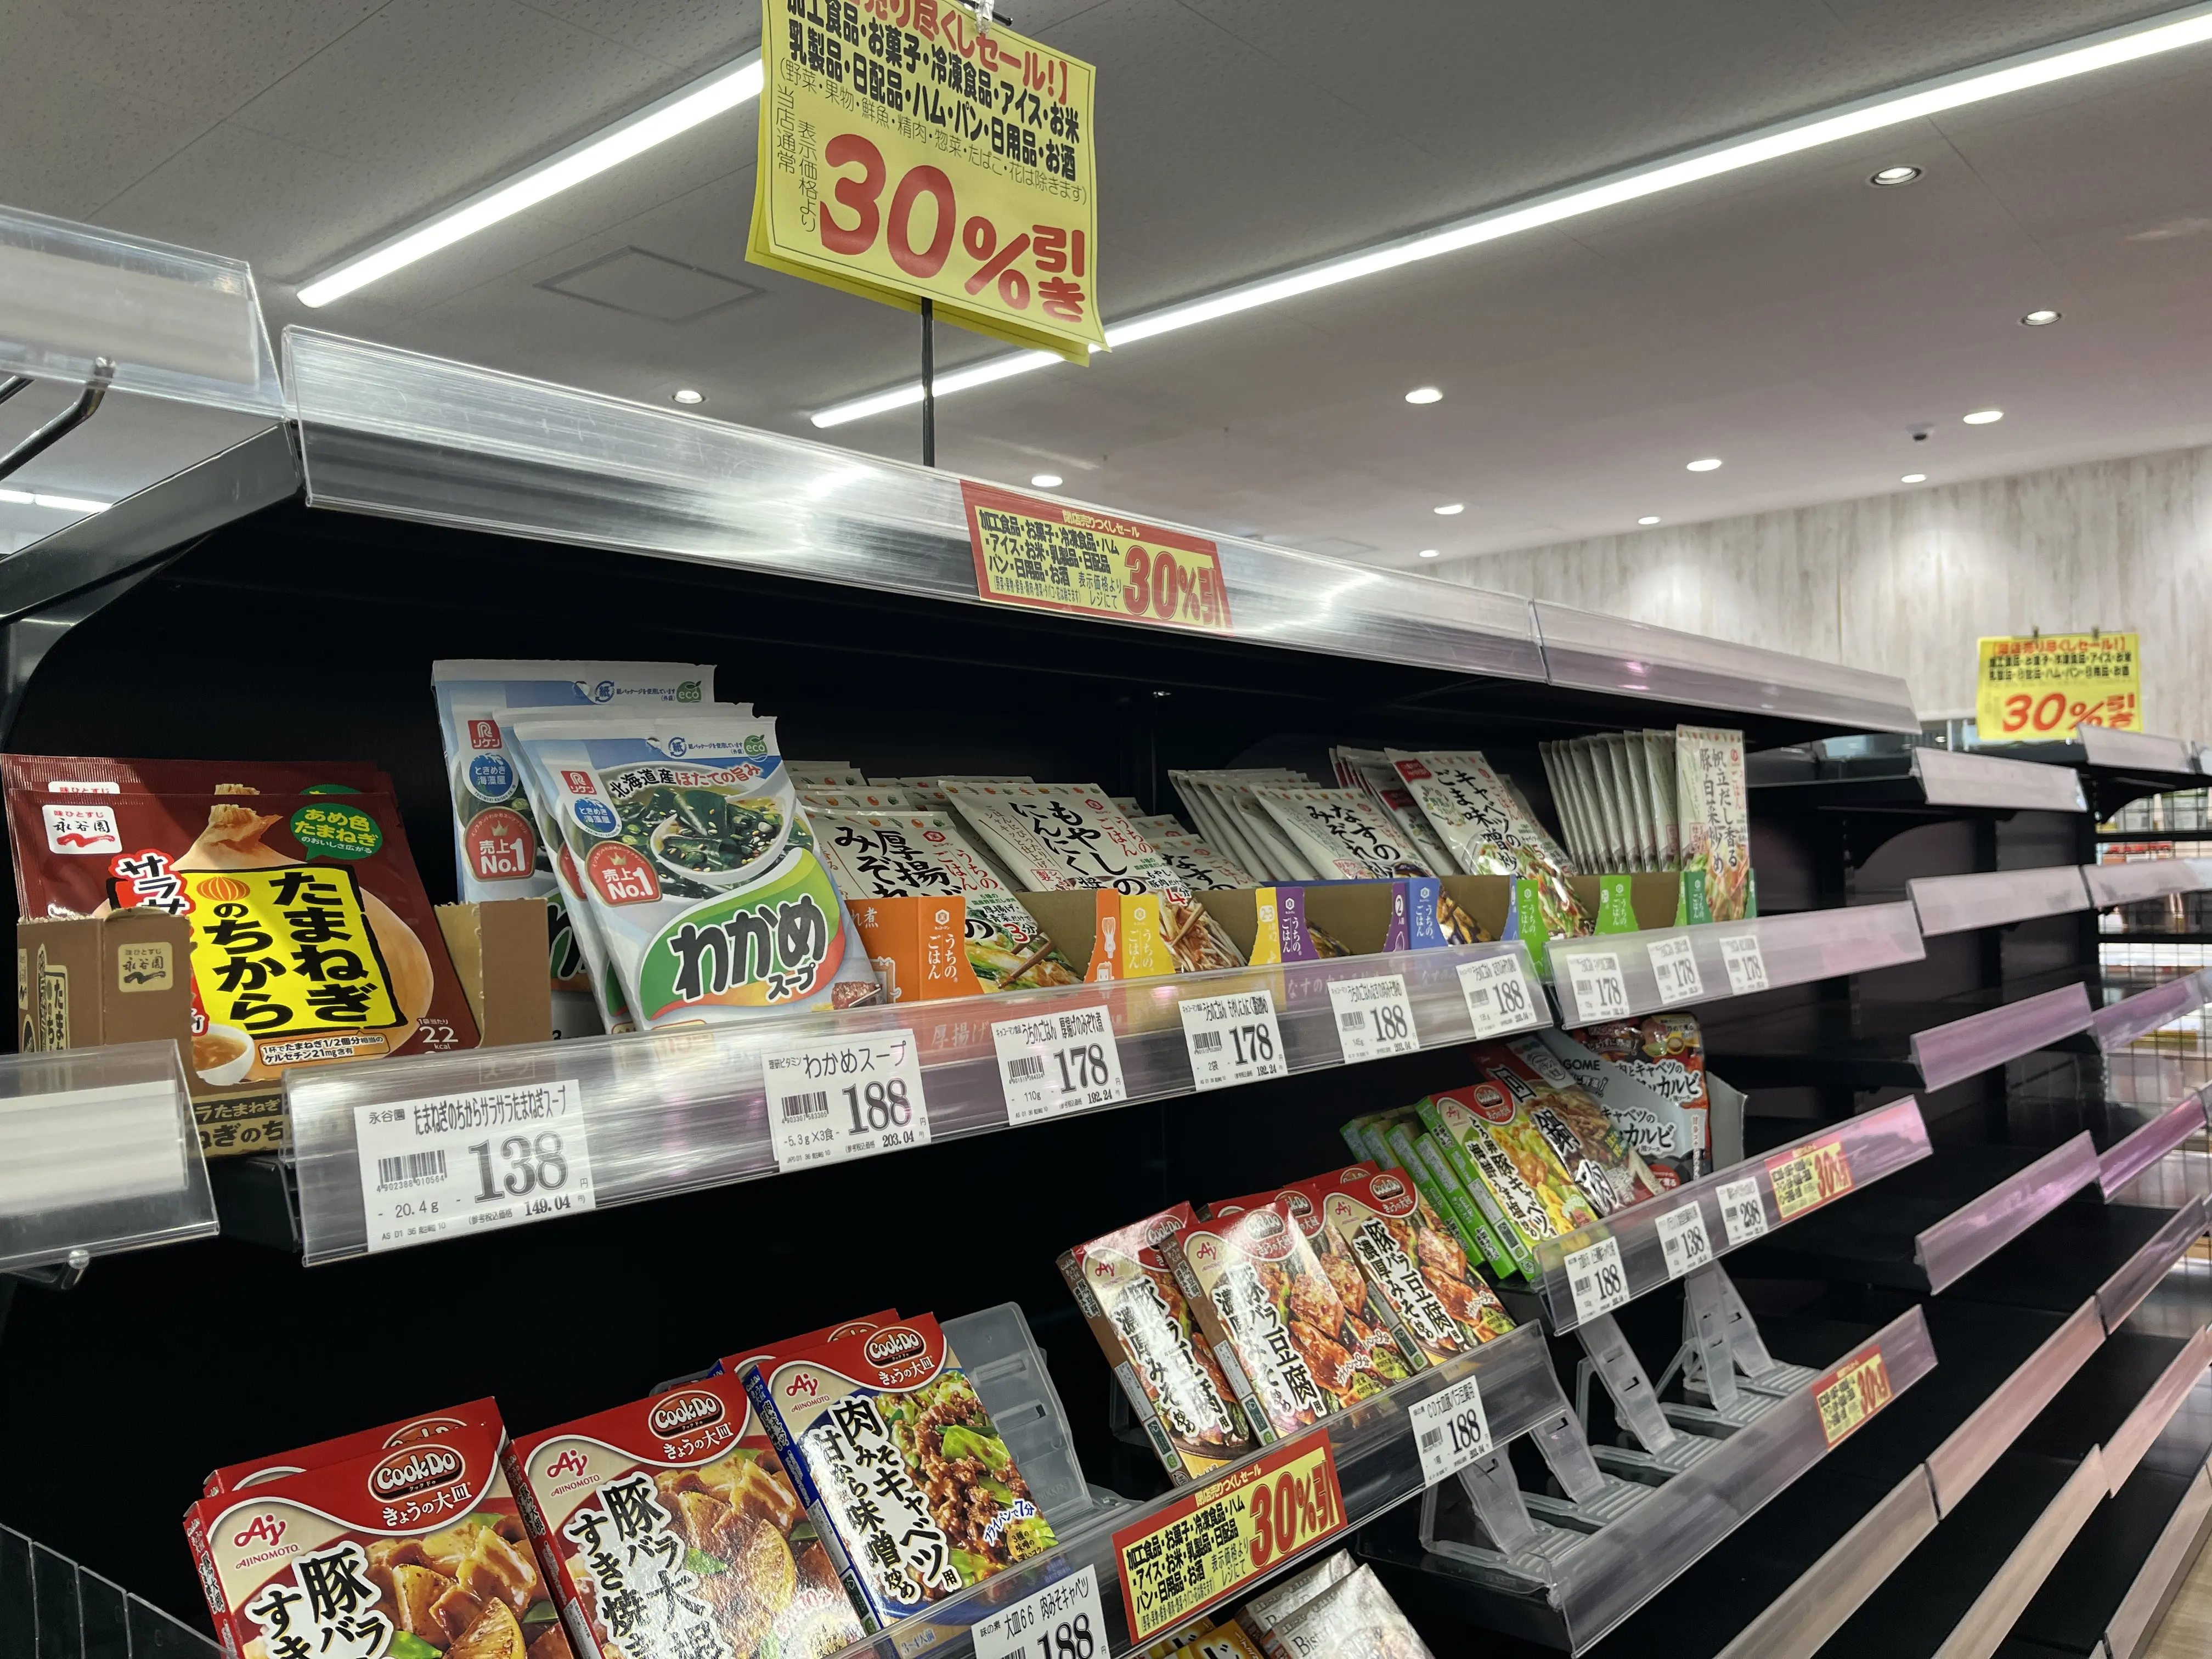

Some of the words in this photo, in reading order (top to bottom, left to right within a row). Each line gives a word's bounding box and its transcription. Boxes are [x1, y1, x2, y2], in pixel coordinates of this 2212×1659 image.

[788, 18, 1076, 182] 乳製品・日配品・ハム・パン・日用品・お酒
[776, 84, 796, 174] 当店通常
[798, 119, 818, 233] 表示価格より
[979, 509, 1120, 556] 加工食品・お菓子・冷凍食品・ハム
[1062, 510, 1140, 538] 閉店売りつくしセール
[989, 553, 1071, 587] パン・日用品・お酒
[1078, 571, 1122, 594] 表示価格より
[1090, 590, 1118, 610] レジにて
[599, 685, 610, 698] 紙
[678, 690, 699, 699] eco
[473, 738, 500, 748] リケン
[672, 742, 683, 752] 紙
[746, 744, 765, 753] eco
[475, 765, 506, 776] ときめき
[477, 775, 506, 786] 海藻屋
[610, 763, 762, 798] 北海道産ほたての旨み
[570, 785, 595, 794] リケン
[53, 810, 104, 818] 味ひとすじ
[304, 809, 370, 832] あめ色
[579, 807, 608, 816] ときめき
[584, 815, 611, 823] 海藻屋
[1700, 748, 1724, 874] 豚白菜炒め
[1712, 748, 1737, 867] 帆立だし香る
[53, 817, 110, 833] 永谷園
[295, 821, 379, 847] たまねぎ
[1097, 817, 1138, 857] ごはん
[1113, 816, 1154, 854] うちの
[301, 836, 373, 854] のおいしさ広がる
[479, 838, 511, 855] 売上
[481, 838, 526, 874] No.1
[602, 867, 635, 883] 売上
[607, 867, 654, 900] No.1
[932, 851, 978, 891] ごはん
[956, 848, 996, 890] うちの
[1165, 887, 1191, 905] 4分
[989, 913, 1032, 923] 青菜だけで
[1002, 922, 1036, 943] 3分
[1415, 906, 1425, 937] ごはん
[1425, 905, 1434, 936] うちの
[269, 870, 378, 1024] たまねぎ
[672, 895, 827, 999] わかめ
[1128, 929, 1139, 969] ごはん
[1143, 929, 1153, 967] うちの
[1282, 917, 1291, 953] ごはん
[1292, 917, 1301, 951] うちの
[202, 902, 294, 1030] のちから
[928, 934, 942, 980] ごはん
[944, 934, 957, 978] うちの
[1741, 956, 1763, 981] 178
[768, 962, 819, 1000] スープ
[1672, 958, 1696, 988] 178
[1492, 979, 1525, 1015] 188
[1595, 977, 1622, 1007] 178
[419, 1026, 459, 1043] 22
[1022, 1019, 1057, 1045] うちのごはん
[1369, 1004, 1408, 1042] 188
[263, 1036, 383, 1054] 1杯でたまねぎ1/2個分相当の
[264, 1047, 354, 1063] ケルセチン21mg含有
[768, 1056, 802, 1070] 理研ビタミン
[803, 1040, 906, 1079] わかめスープ
[1228, 1023, 1273, 1066] 178
[1053, 1043, 1109, 1094] 178
[1563, 1059, 1600, 1071] GOME
[842, 1078, 912, 1136] 188
[1024, 1090, 1041, 1102] 110g
[1087, 1089, 1113, 1104] 192.24
[369, 1108, 405, 1125] 永谷園
[920, 1117, 927, 1126] 円
[1601, 1106, 1655, 1124] キャベツの
[882, 1130, 915, 1148] 203.04
[467, 1130, 568, 1204] 138
[580, 1178, 589, 1188] 円
[524, 1194, 571, 1217] 149.04
[1680, 1226, 1706, 1260] 138
[1364, 1221, 1462, 1340] 豚バラ豆腐用
[1594, 1263, 1622, 1301] 188
[878, 1356, 935, 1386] きょうの大皿
[791, 1395, 830, 1413] AJINOMOTO
[663, 1424, 733, 1460] きょうの大皿
[1447, 1409, 1481, 1454] 188
[551, 1474, 601, 1497] AJINOMOTO
[832, 1398, 958, 1584] 肉みそキャベツ用
[1195, 1464, 1262, 1507] 閉店売りつくしセール
[382, 1483, 472, 1526] きょうの大皿
[984, 1500, 1035, 1543] フライパンで7分
[1013, 1531, 1029, 1542] 3種の
[1126, 1494, 1245, 1571] 加工食品・お菓子・冷凍食品・ハム
[235, 1544, 300, 1569] AJINOMOTO
[1014, 1540, 1035, 1553] 味噌の
[1211, 1537, 1249, 1573] 表示価格より
[1136, 1560, 1206, 1615] パン・日用品・お酒
[1222, 1559, 1246, 1586] レジにて
[980, 1620, 1001, 1638] 味の素
[1040, 1576, 1089, 1621] 肉みそキャベツ
[1037, 1612, 1094, 1659] 188
